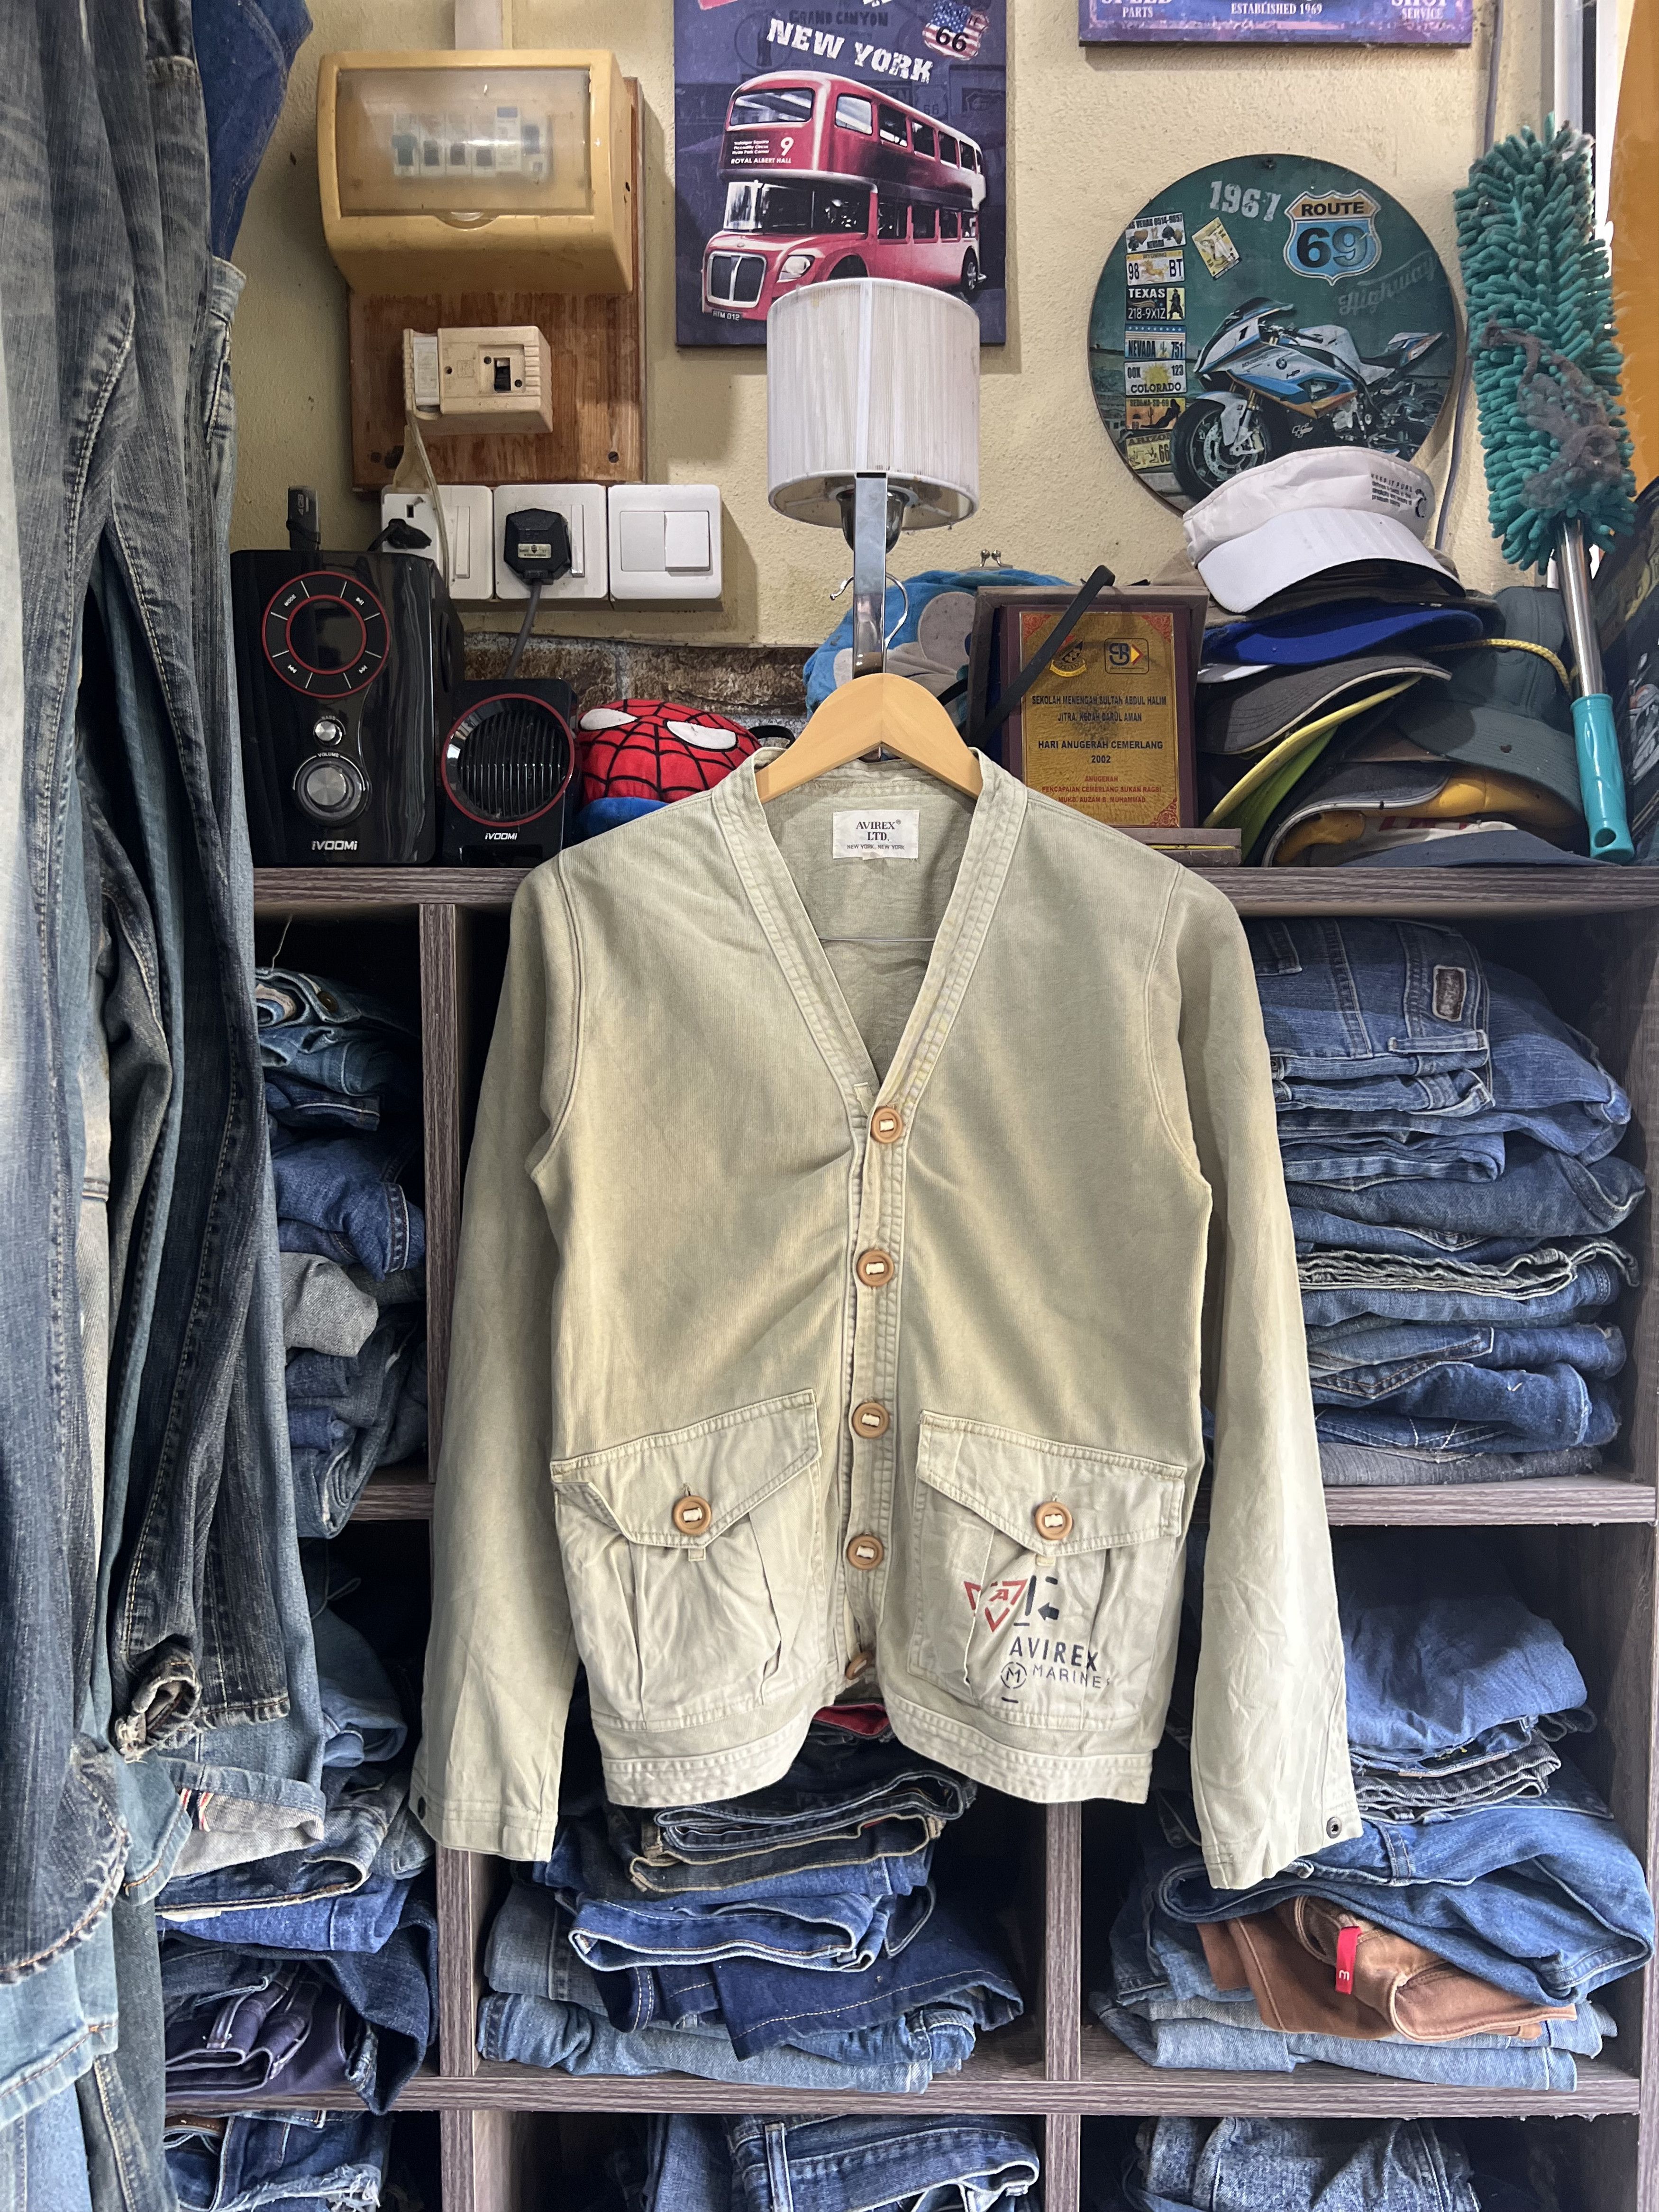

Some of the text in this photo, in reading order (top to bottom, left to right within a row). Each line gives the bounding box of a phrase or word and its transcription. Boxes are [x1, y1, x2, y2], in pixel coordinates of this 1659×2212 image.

[1122, 7, 1153, 18] PARTS
[1231, 2, 1322, 15] ESTABLISHED 1969
[1402, 7, 1444, 20] SERVICE
[936, 26, 967, 52] 66
[766, 18, 934, 84] NEW YORK
[780, 137, 794, 156] 9
[1209, 181, 1282, 222] 1967
[1301, 201, 1365, 216] ROUTE
[1296, 226, 1368, 268] 69
[1128, 263, 1139, 280] 98
[1169, 259, 1183, 277] BT
[1128, 288, 1165, 299] TEXAS
[726, 312, 740, 321] 012
[1128, 340, 1156, 358] NEVADA
[1171, 340, 1183, 358] 751
[1171, 364, 1184, 376] 123
[1130, 382, 1182, 393] COLORADO
[284, 594, 297, 607] MODE
[1032, 695, 1167, 705] SEKOLAH MENENGAH SULTAN ABDUL HALIM
[1079, 712, 1100, 721] KEDAH
[1102, 712, 1122, 721] DARUL
[1124, 712, 1142, 721] AMAN
[1038, 740, 1163, 749] HARI ANUGERAH CEMERLANG
[1091, 755, 1111, 764] 2002
[867, 832, 890, 841] LTD.
[1009, 1636, 1099, 1672] AVIREX
[1006, 1667, 1021, 1683] M
